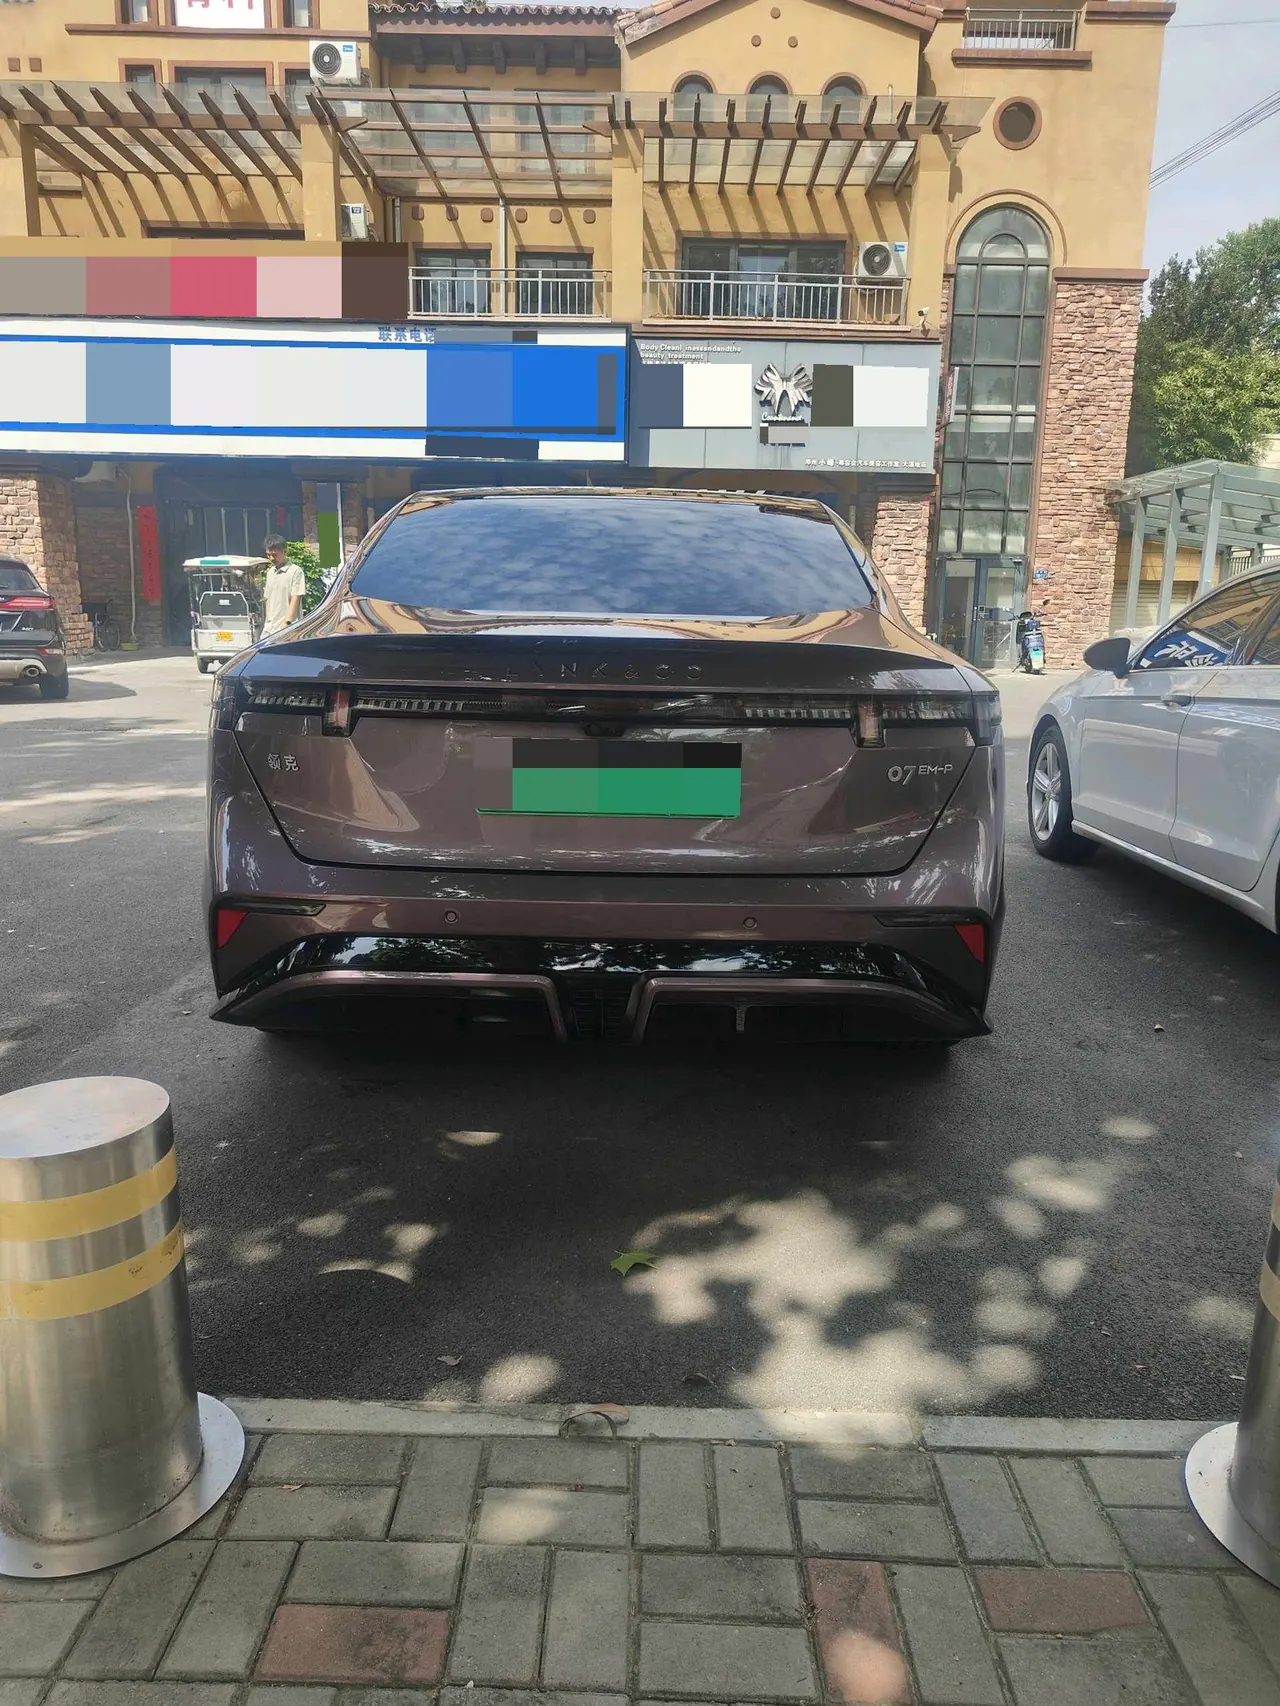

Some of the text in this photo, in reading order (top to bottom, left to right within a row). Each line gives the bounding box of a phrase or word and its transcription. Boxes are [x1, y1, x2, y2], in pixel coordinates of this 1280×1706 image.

[640, 344, 658, 352] Body
[640, 352, 664, 360] beauty
[267, 753, 299, 771] 领克
[887, 764, 953, 785] 07 EM-P
